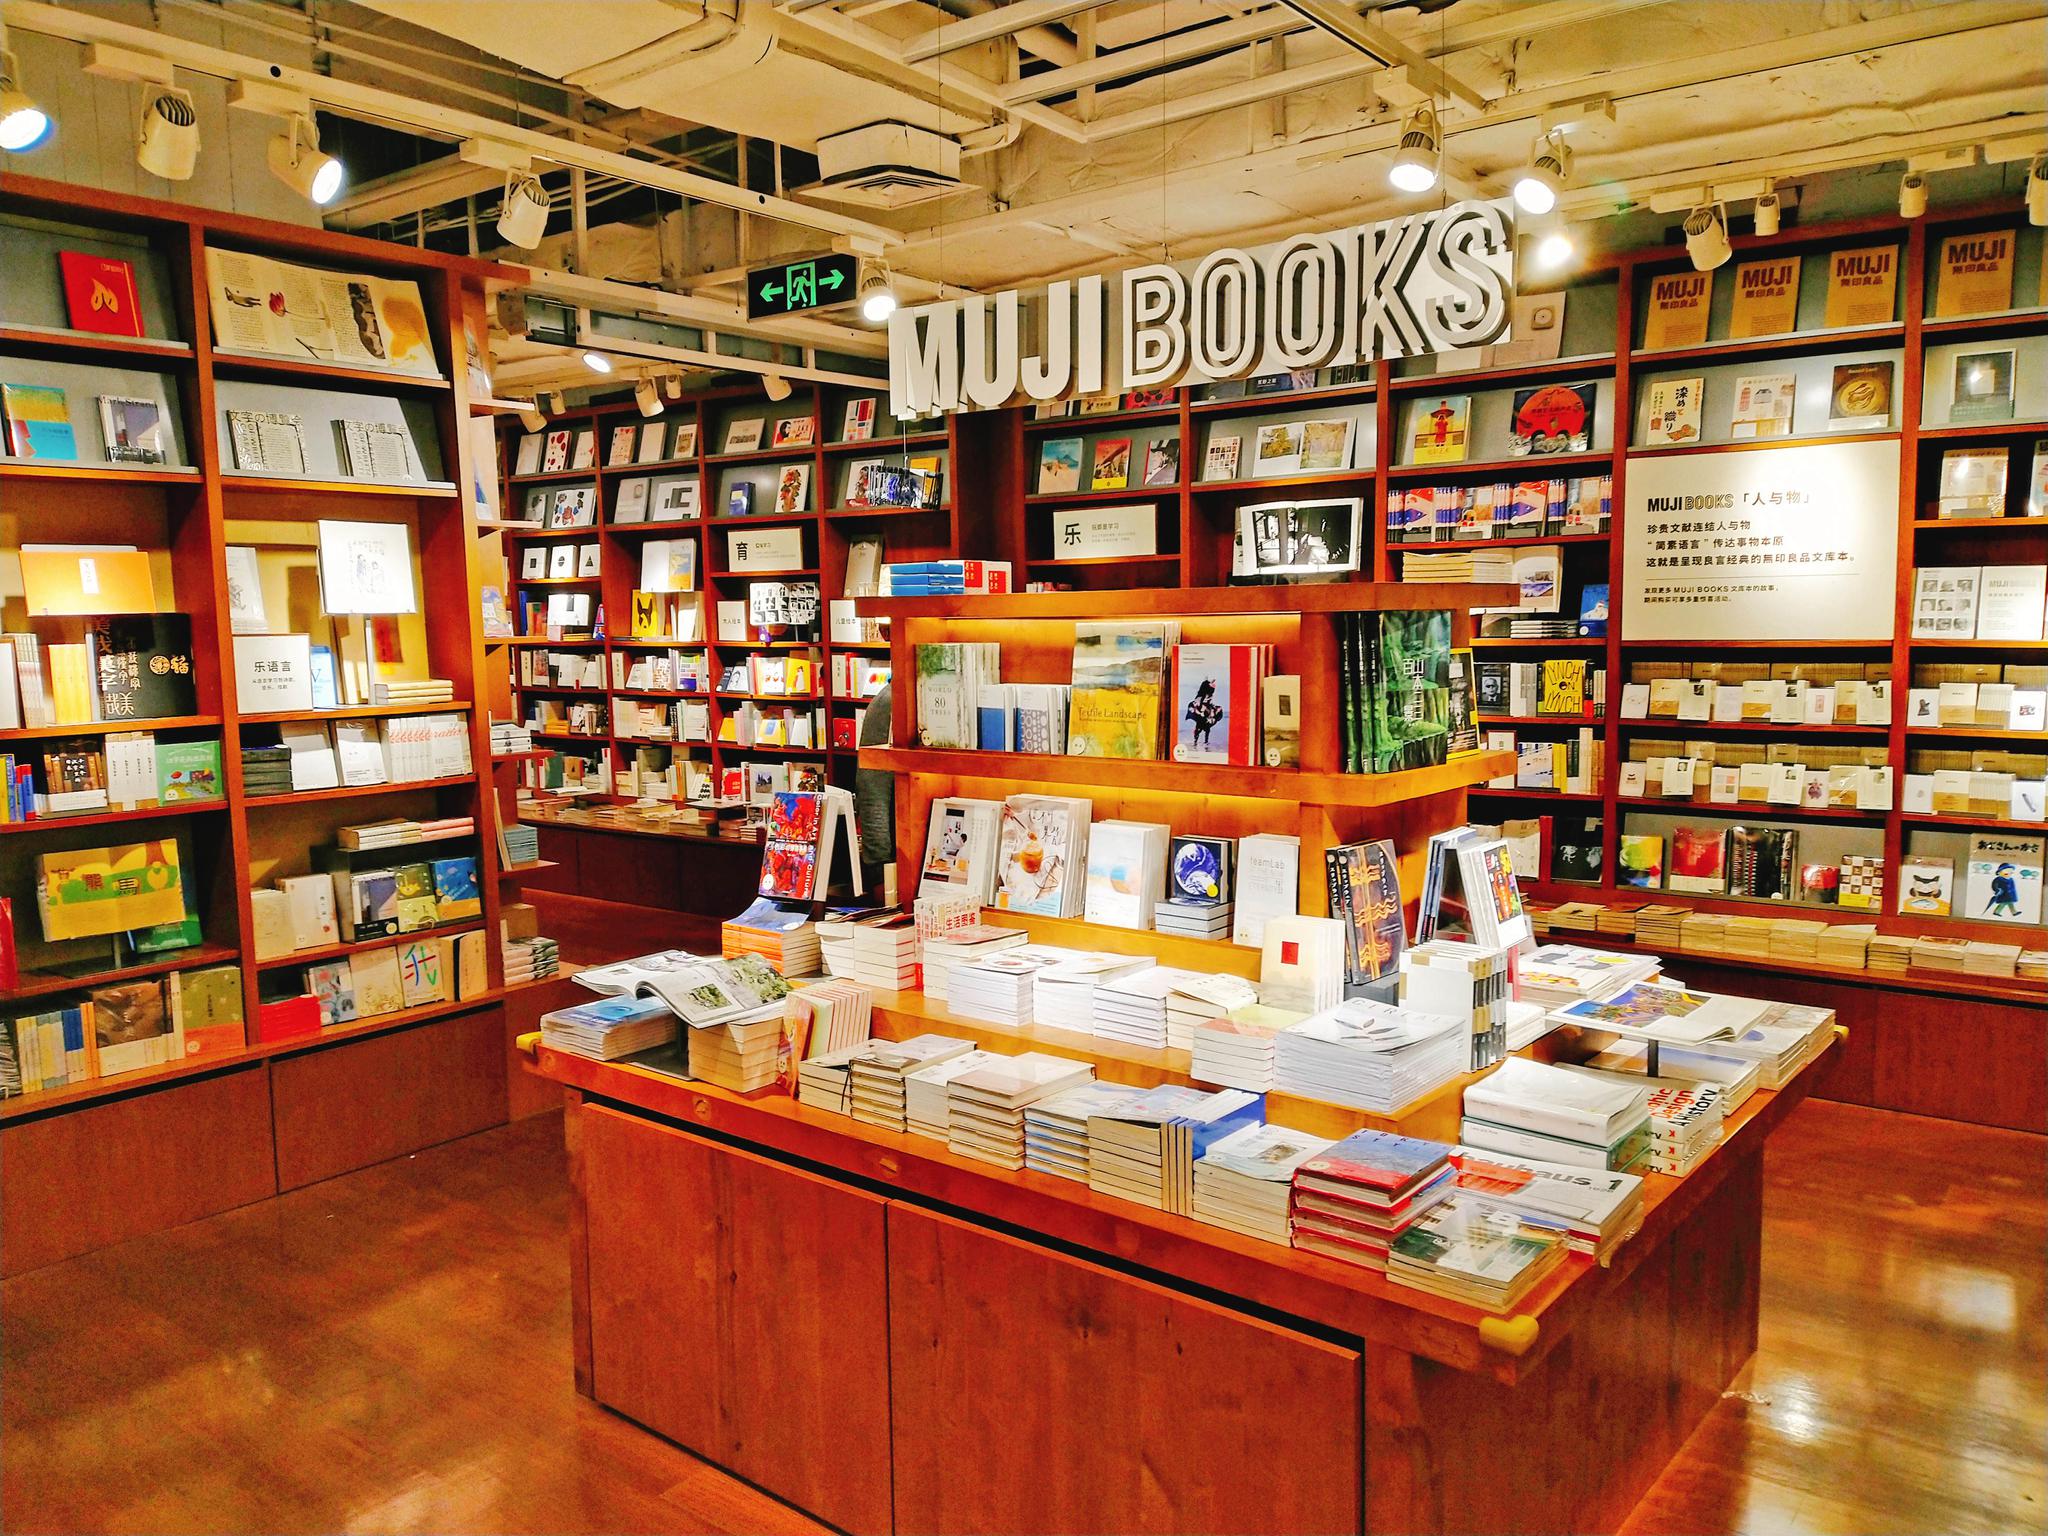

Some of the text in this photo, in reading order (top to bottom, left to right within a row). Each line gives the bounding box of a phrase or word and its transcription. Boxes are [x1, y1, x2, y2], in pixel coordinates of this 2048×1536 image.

[1948, 239, 2006, 263] MUJI
[1836, 254, 1890, 276] MUJI
[1952, 262, 1999, 275] 無印良品
[1742, 266, 1792, 288] MUJI
[1841, 276, 1883, 287] 無印良品
[1656, 278, 1705, 300] MUJI
[1745, 287, 1785, 298] 無印良品
[889, 200, 1508, 418] MUJI BOOKS
[1660, 299, 1698, 310] 無印良品
[1647, 496, 1682, 512] MUJI
[1684, 494, 1734, 511] BOOKS
[1064, 523, 1082, 545] 乐
[1647, 520, 1751, 534] 珍贵文献连结人与物
[736, 541, 749, 561] 育
[1697, 585, 1729, 593] BOOKS
[254, 660, 292, 673] 乐语言
[928, 686, 952, 694] WORLD
[934, 697, 946, 708] 80
[1249, 855, 1285, 870] teamLab
[1650, 1090, 1695, 1119] Design
[1606, 1179, 1624, 1191] 1
